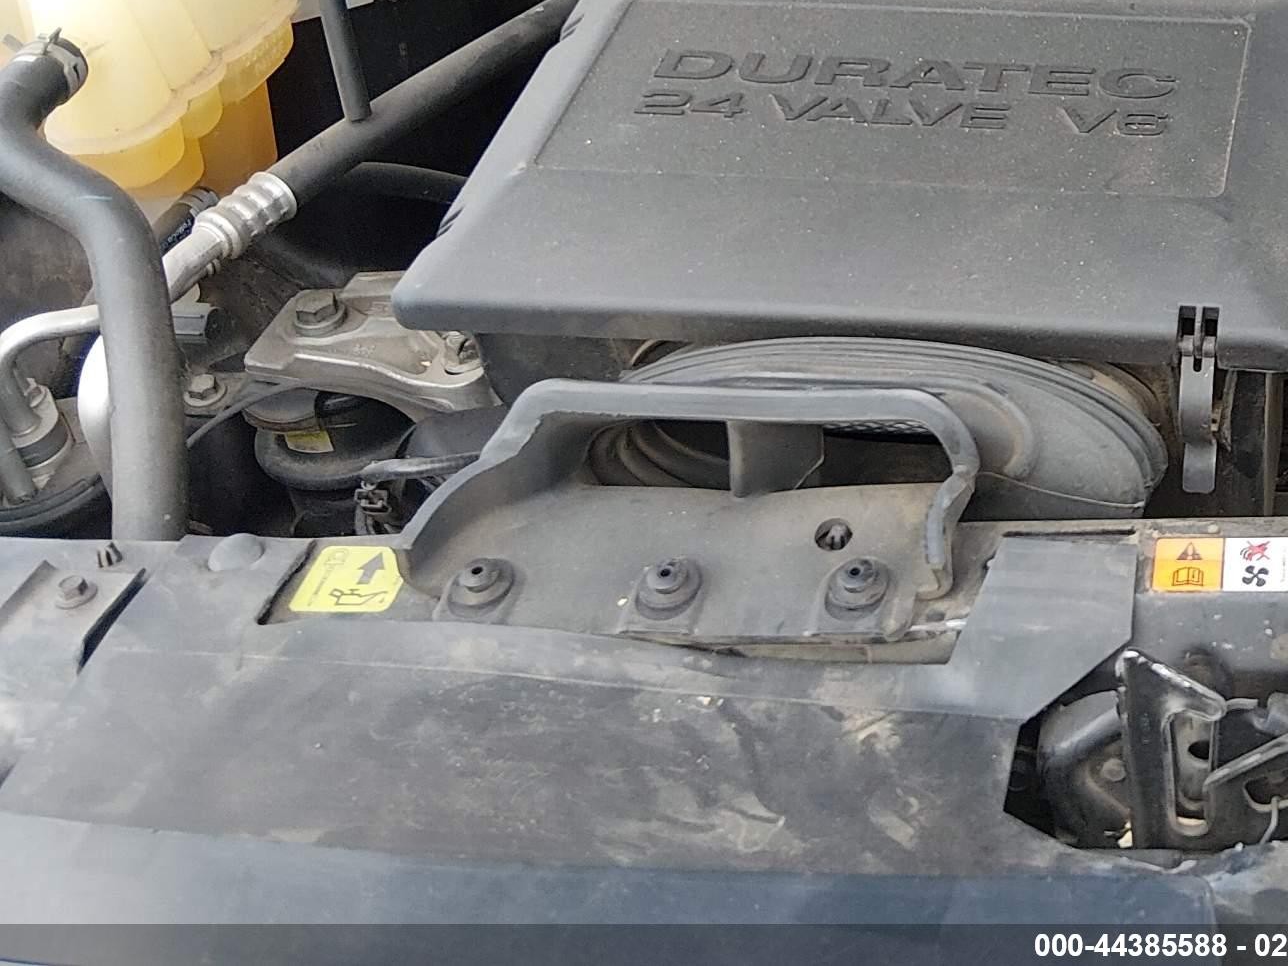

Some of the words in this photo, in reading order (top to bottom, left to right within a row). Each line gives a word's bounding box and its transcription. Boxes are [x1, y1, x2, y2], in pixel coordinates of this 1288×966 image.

[654, 50, 1178, 99] DURATEC
[634, 92, 748, 119] 24
[769, 94, 1010, 130] VALVE
[1058, 106, 1170, 137] V6
